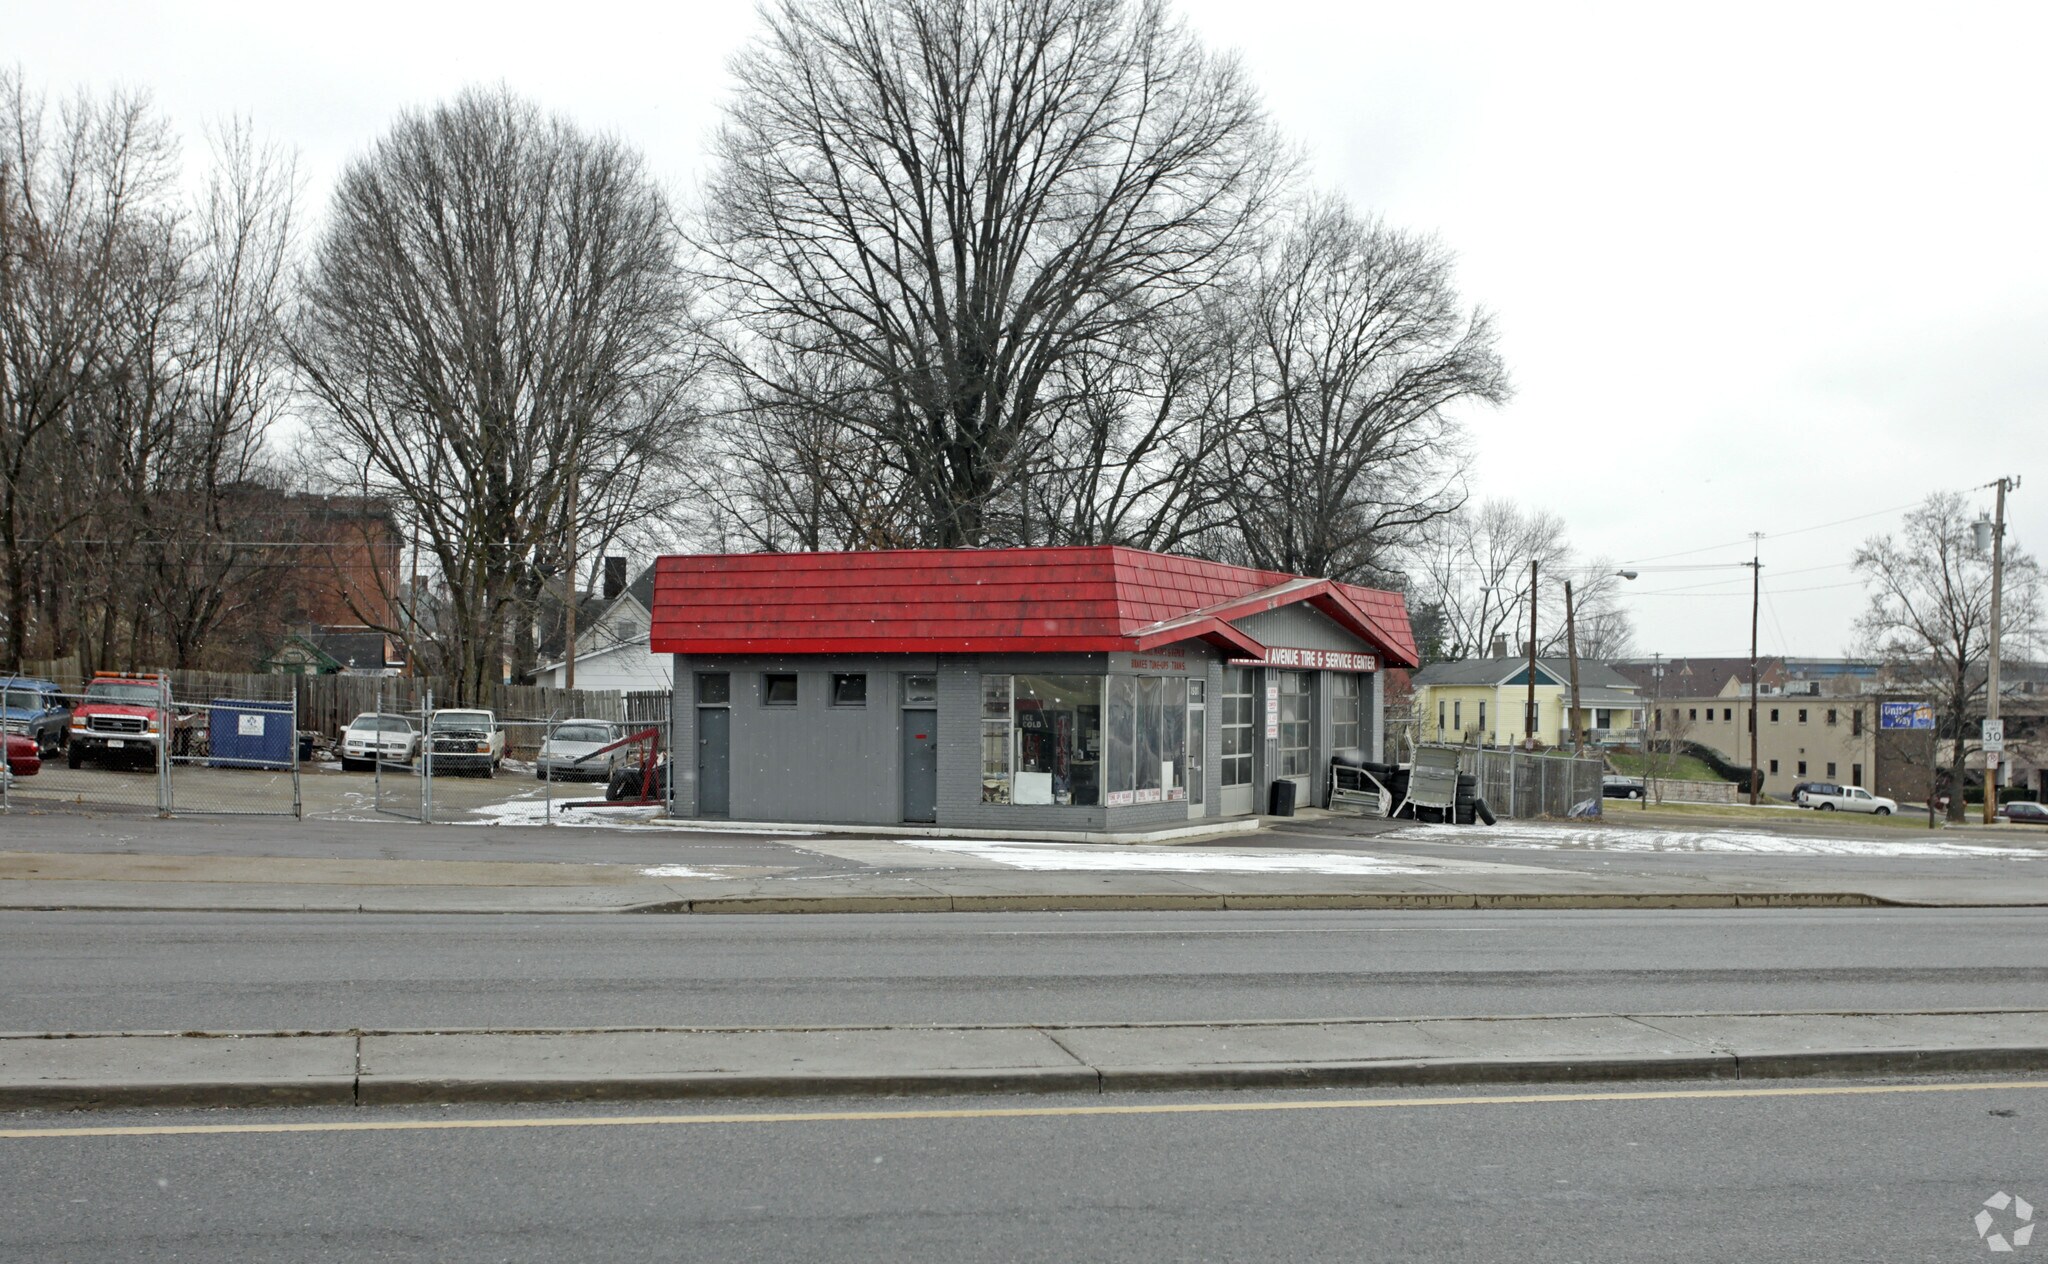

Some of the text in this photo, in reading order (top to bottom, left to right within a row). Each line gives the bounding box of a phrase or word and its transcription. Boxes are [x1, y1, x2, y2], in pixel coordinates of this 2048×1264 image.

[1271, 648, 1299, 665] AVENUE
[1300, 650, 1315, 666] TIRE
[1317, 651, 1323, 667] &
[1325, 652, 1351, 668] SERVICE
[1353, 654, 1375, 670] CENTER
[1896, 716, 1912, 727] Way
[1985, 732, 2001, 742] 30
